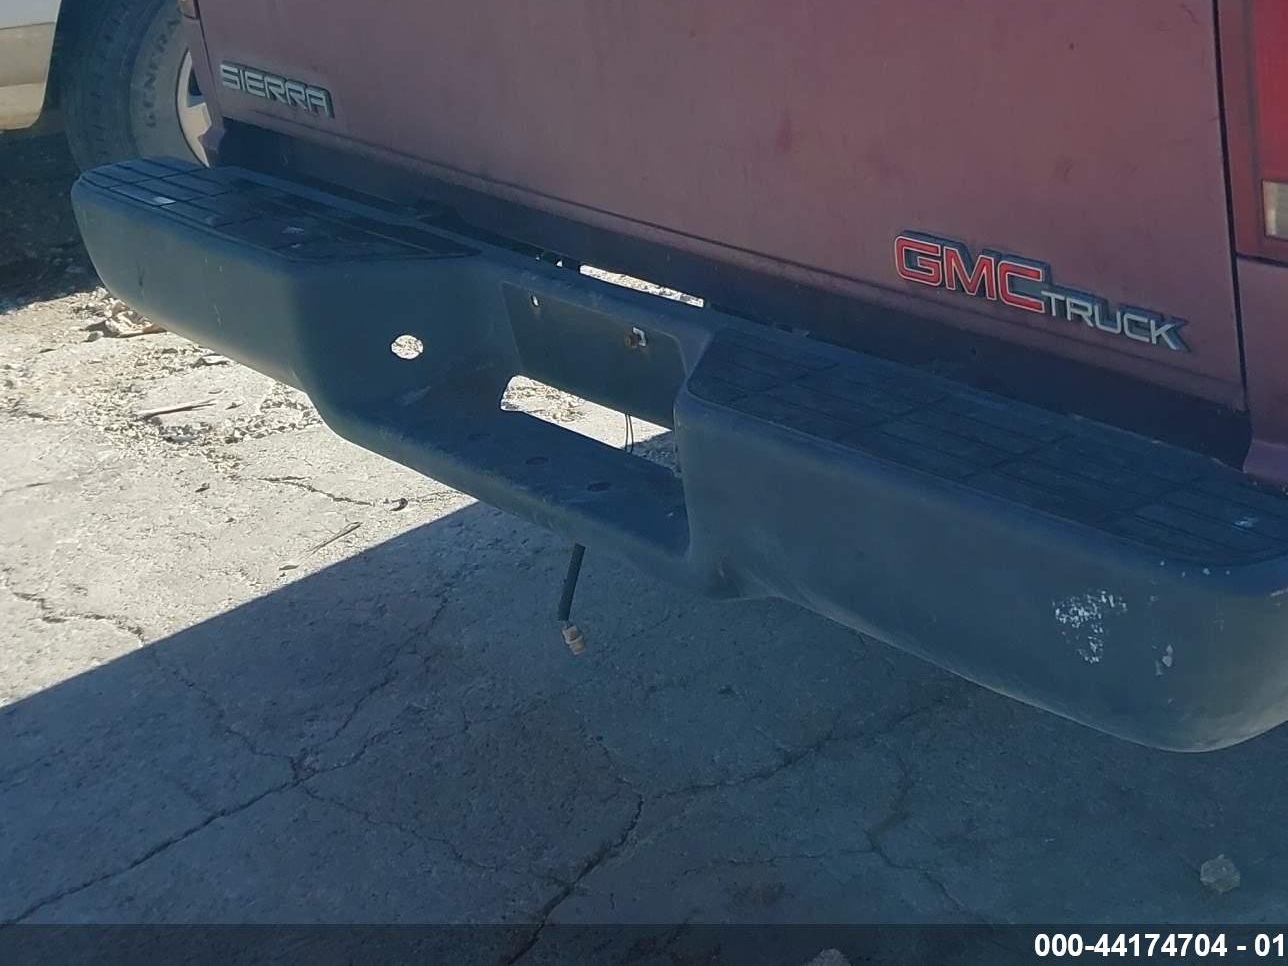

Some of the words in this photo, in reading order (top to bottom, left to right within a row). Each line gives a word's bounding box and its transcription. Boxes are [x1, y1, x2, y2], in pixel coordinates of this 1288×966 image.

[219, 63, 332, 121] SIERRA
[894, 234, 1046, 314] GMC
[1040, 289, 1181, 351] TRUCK
